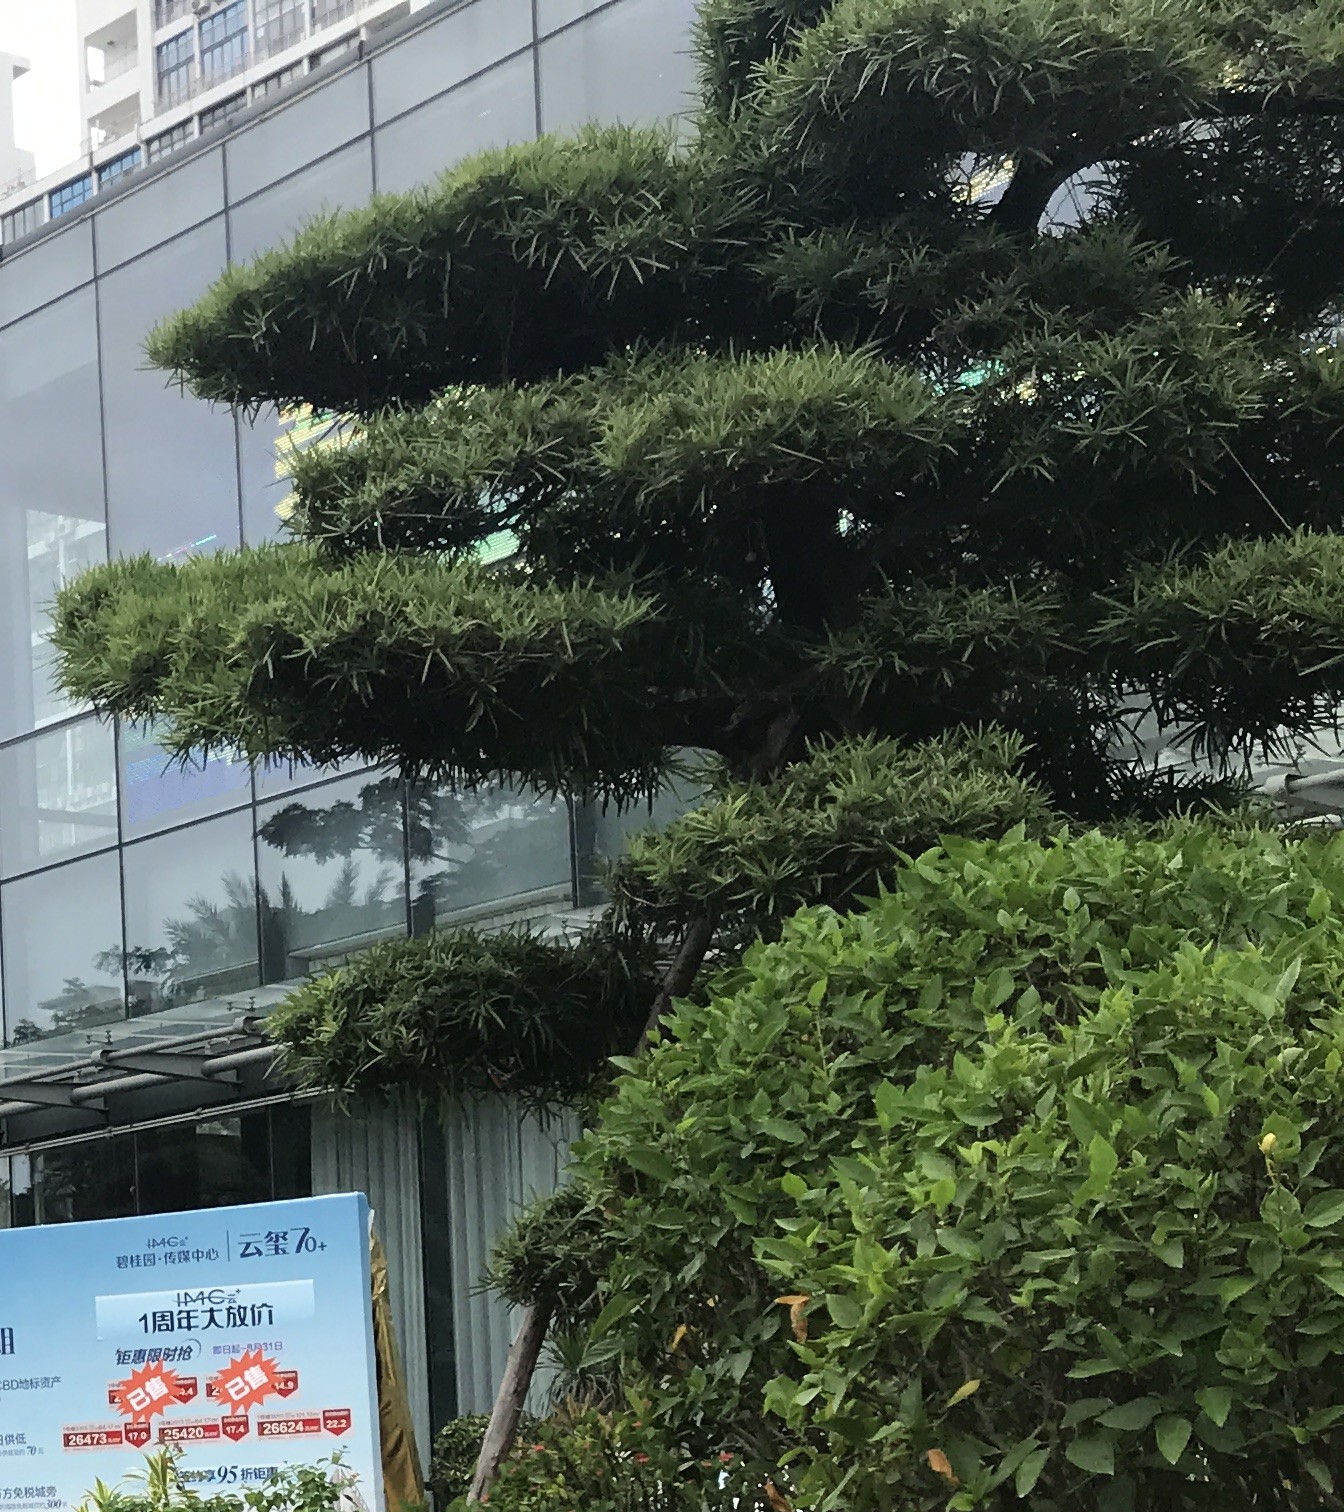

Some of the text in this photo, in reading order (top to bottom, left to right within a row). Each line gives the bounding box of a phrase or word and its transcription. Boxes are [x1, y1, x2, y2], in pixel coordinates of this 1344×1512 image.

[138, 1302, 274, 1334] 1周年大放价
[126, 1375, 170, 1412] 已售
[224, 1364, 270, 1401] 已售
[68, 1433, 108, 1446] 26473
[163, 1427, 204, 1440] 25420
[262, 1421, 304, 1435] 26624
